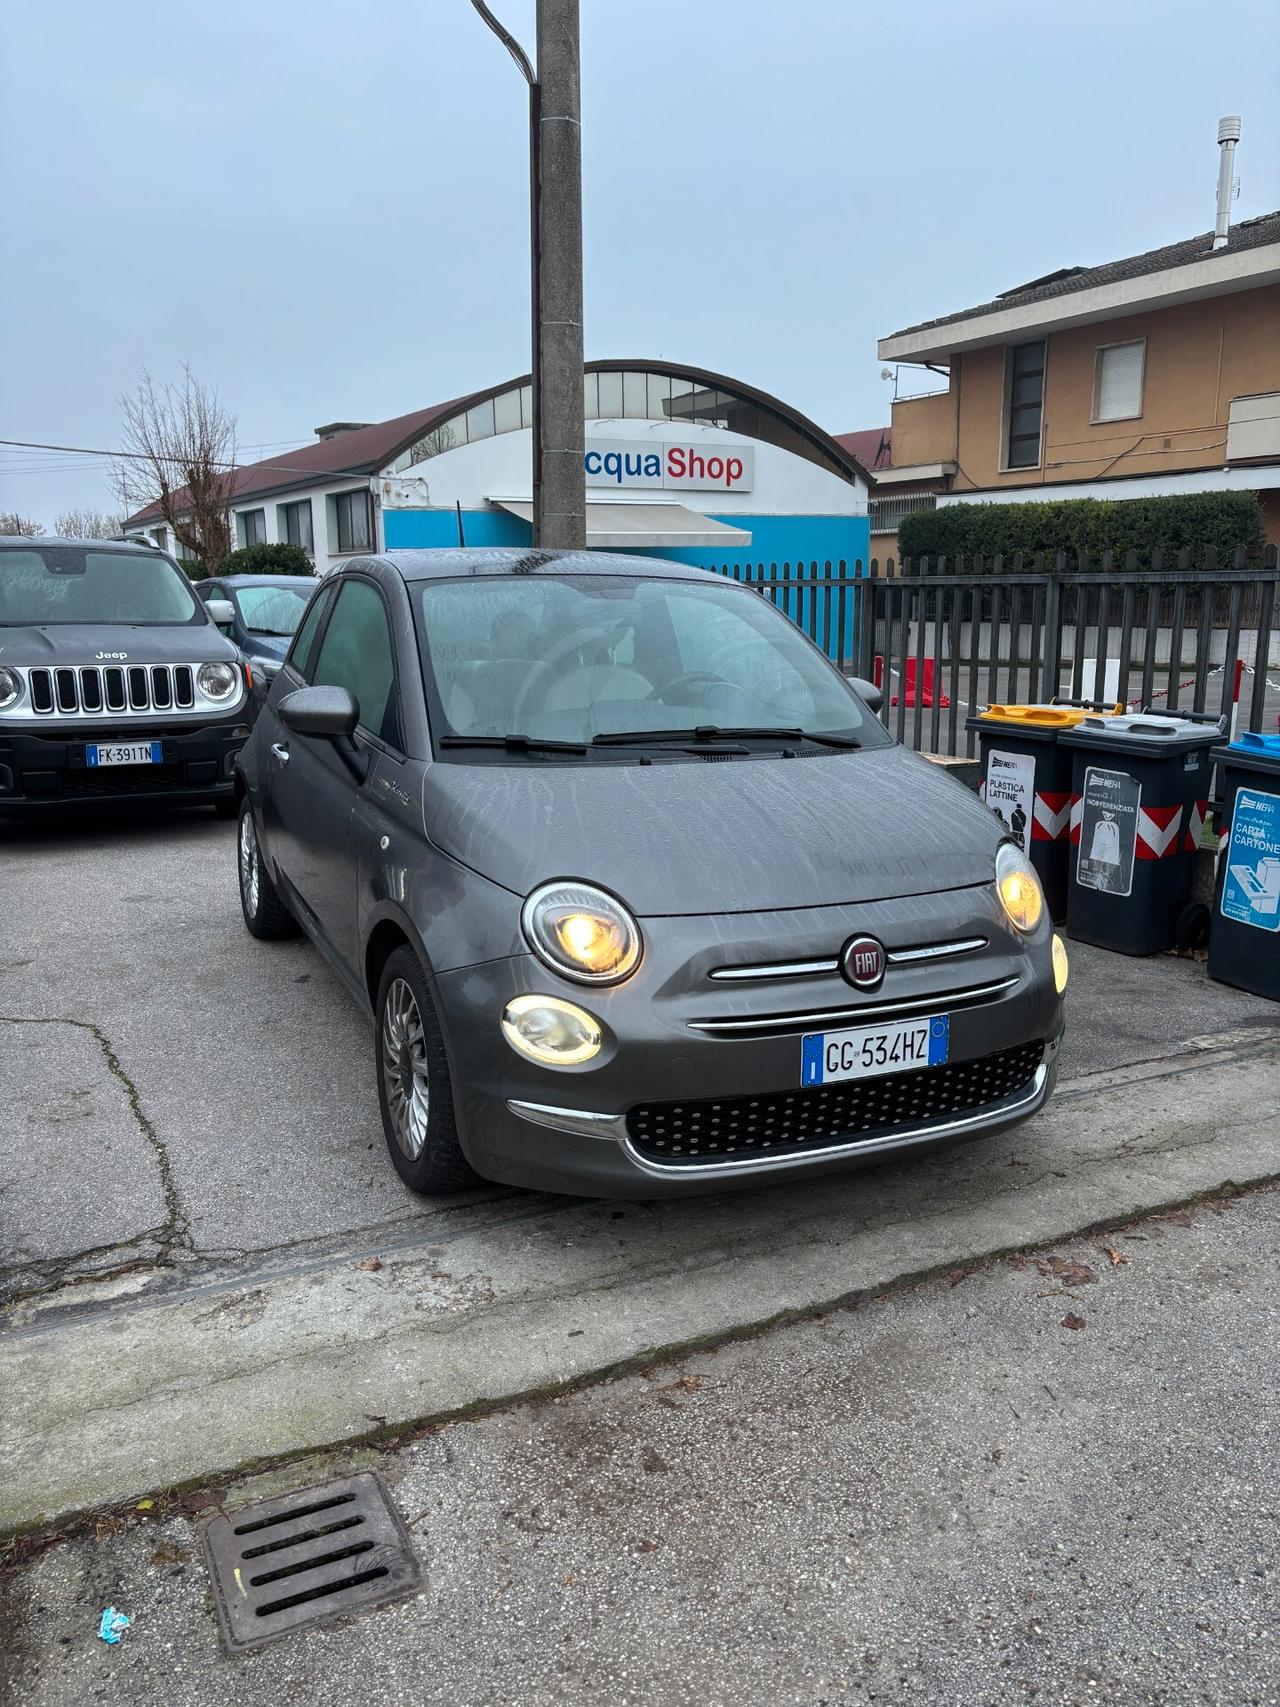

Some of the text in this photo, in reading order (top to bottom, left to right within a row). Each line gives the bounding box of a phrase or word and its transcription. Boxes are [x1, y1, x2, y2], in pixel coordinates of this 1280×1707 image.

[585, 447, 743, 487] cqua Shop
[95, 651, 128, 660] Jeep
[989, 779, 1025, 793] PLASTICA
[989, 788, 1018, 802] LATTINE
[1255, 801, 1275, 813] HERA
[1235, 822, 1266, 839] CARTA
[1234, 833, 1280, 855] CARTONE
[855, 951, 878, 974] FIAT
